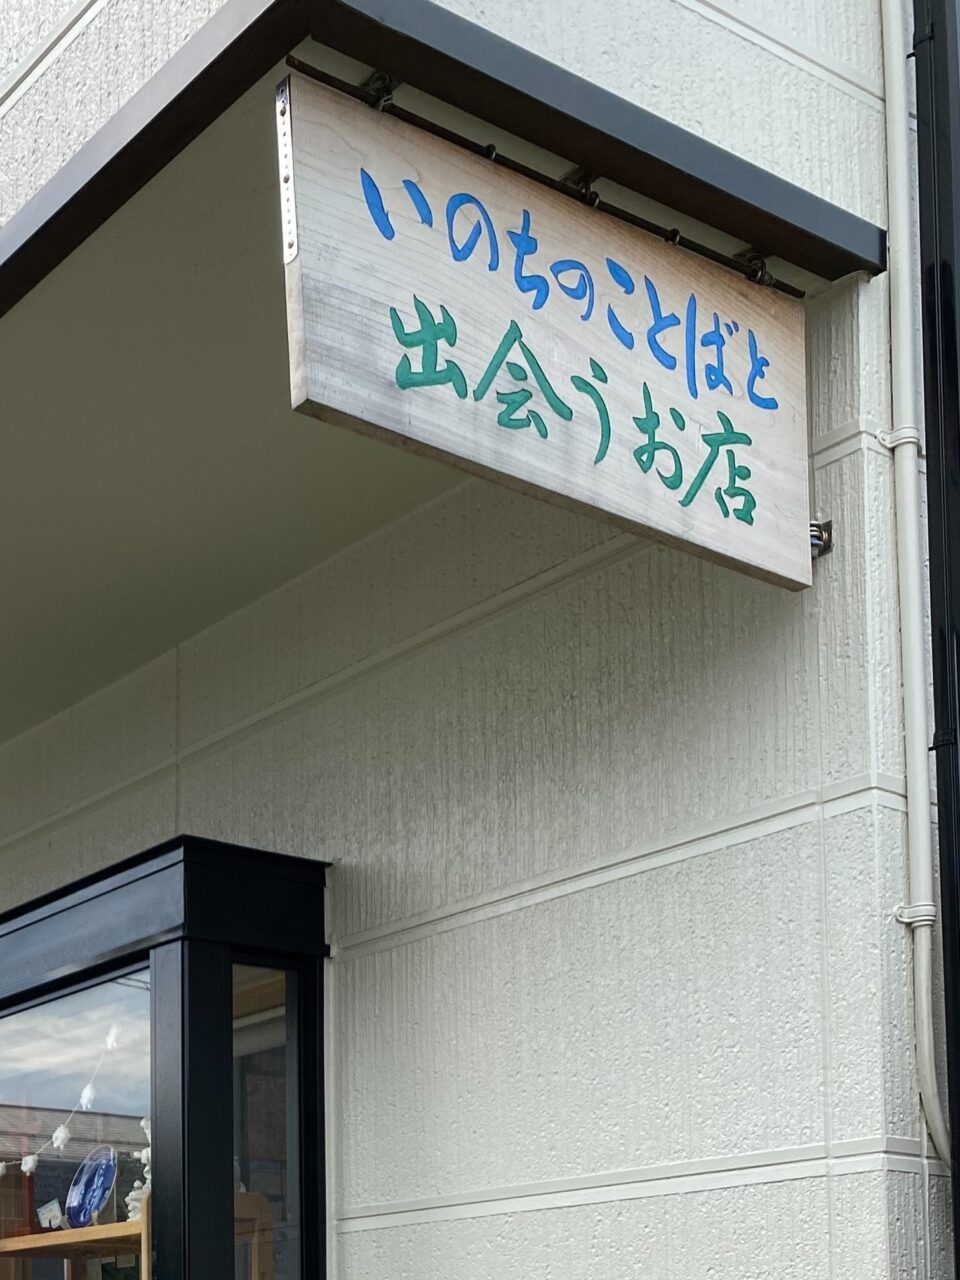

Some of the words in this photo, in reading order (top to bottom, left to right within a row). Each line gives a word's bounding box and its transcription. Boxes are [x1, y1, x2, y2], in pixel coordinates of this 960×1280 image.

[360, 167, 778, 410] いのちのことばと
[391, 294, 754, 526] 出会うお店
